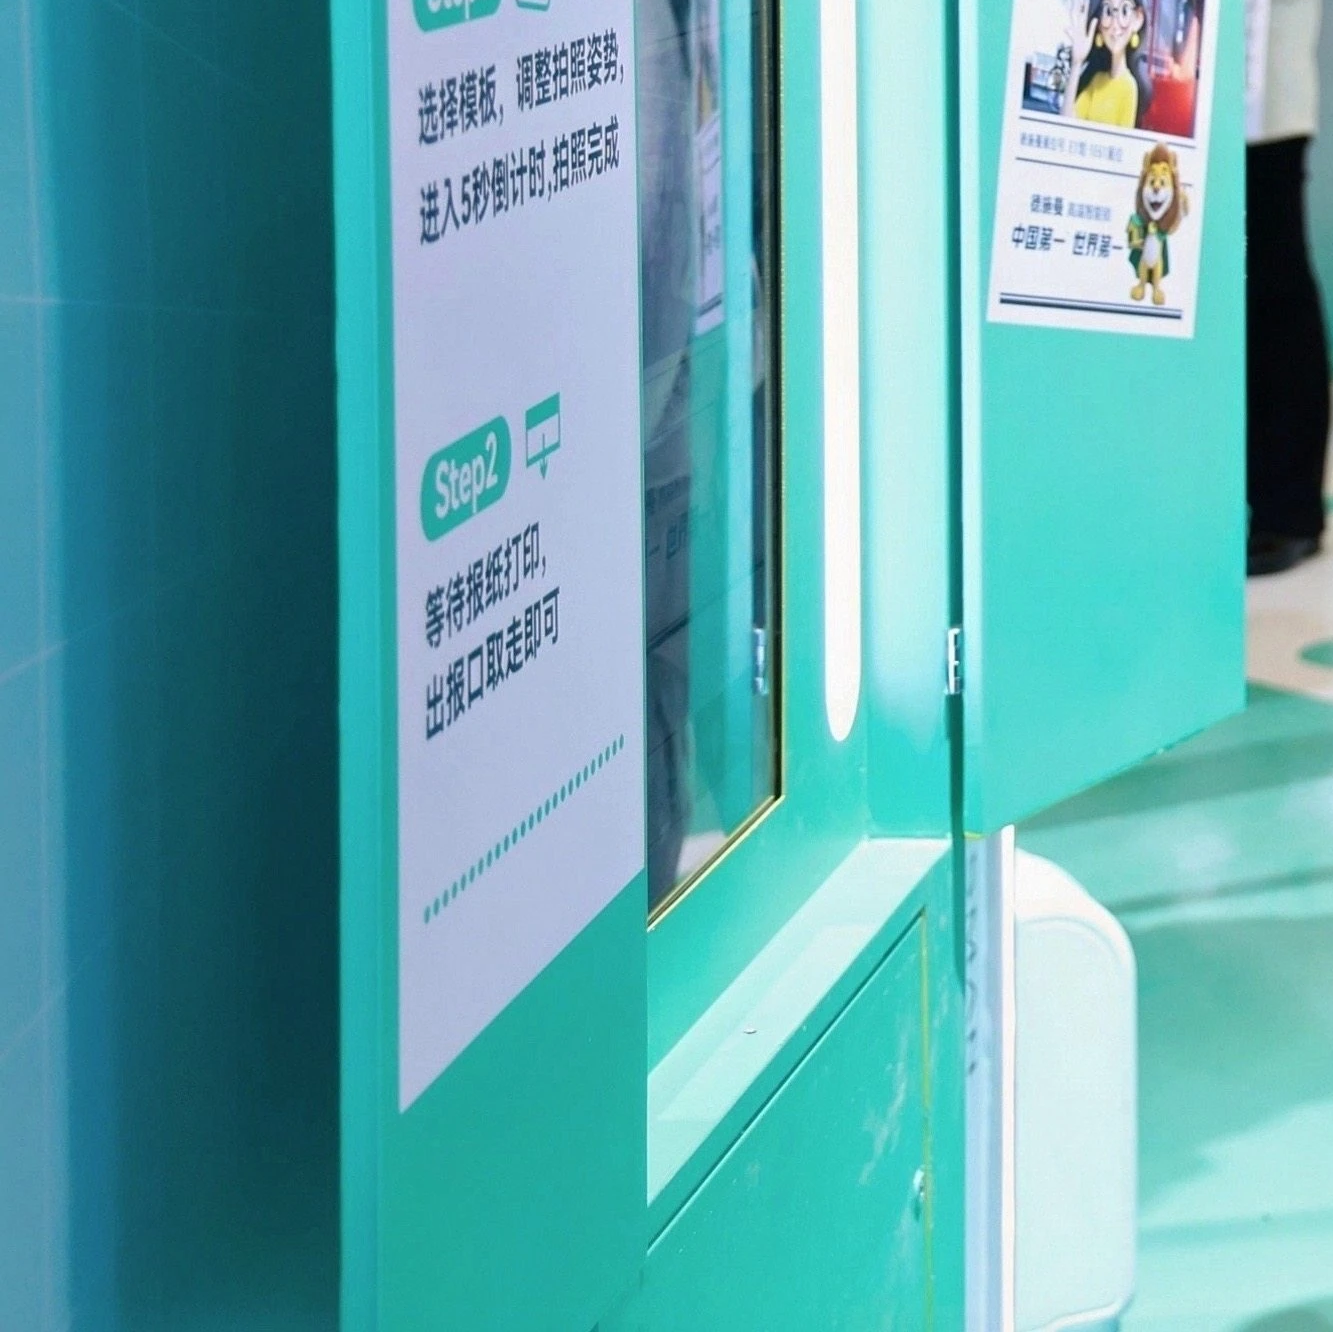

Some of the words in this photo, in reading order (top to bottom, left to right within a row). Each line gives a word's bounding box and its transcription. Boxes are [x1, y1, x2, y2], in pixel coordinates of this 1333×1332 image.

[1011, 222, 1066, 251] 中国第一
[1072, 230, 1124, 258] 世界第一
[434, 430, 499, 521] Step2
[425, 586, 561, 741] 出报口取走即可
